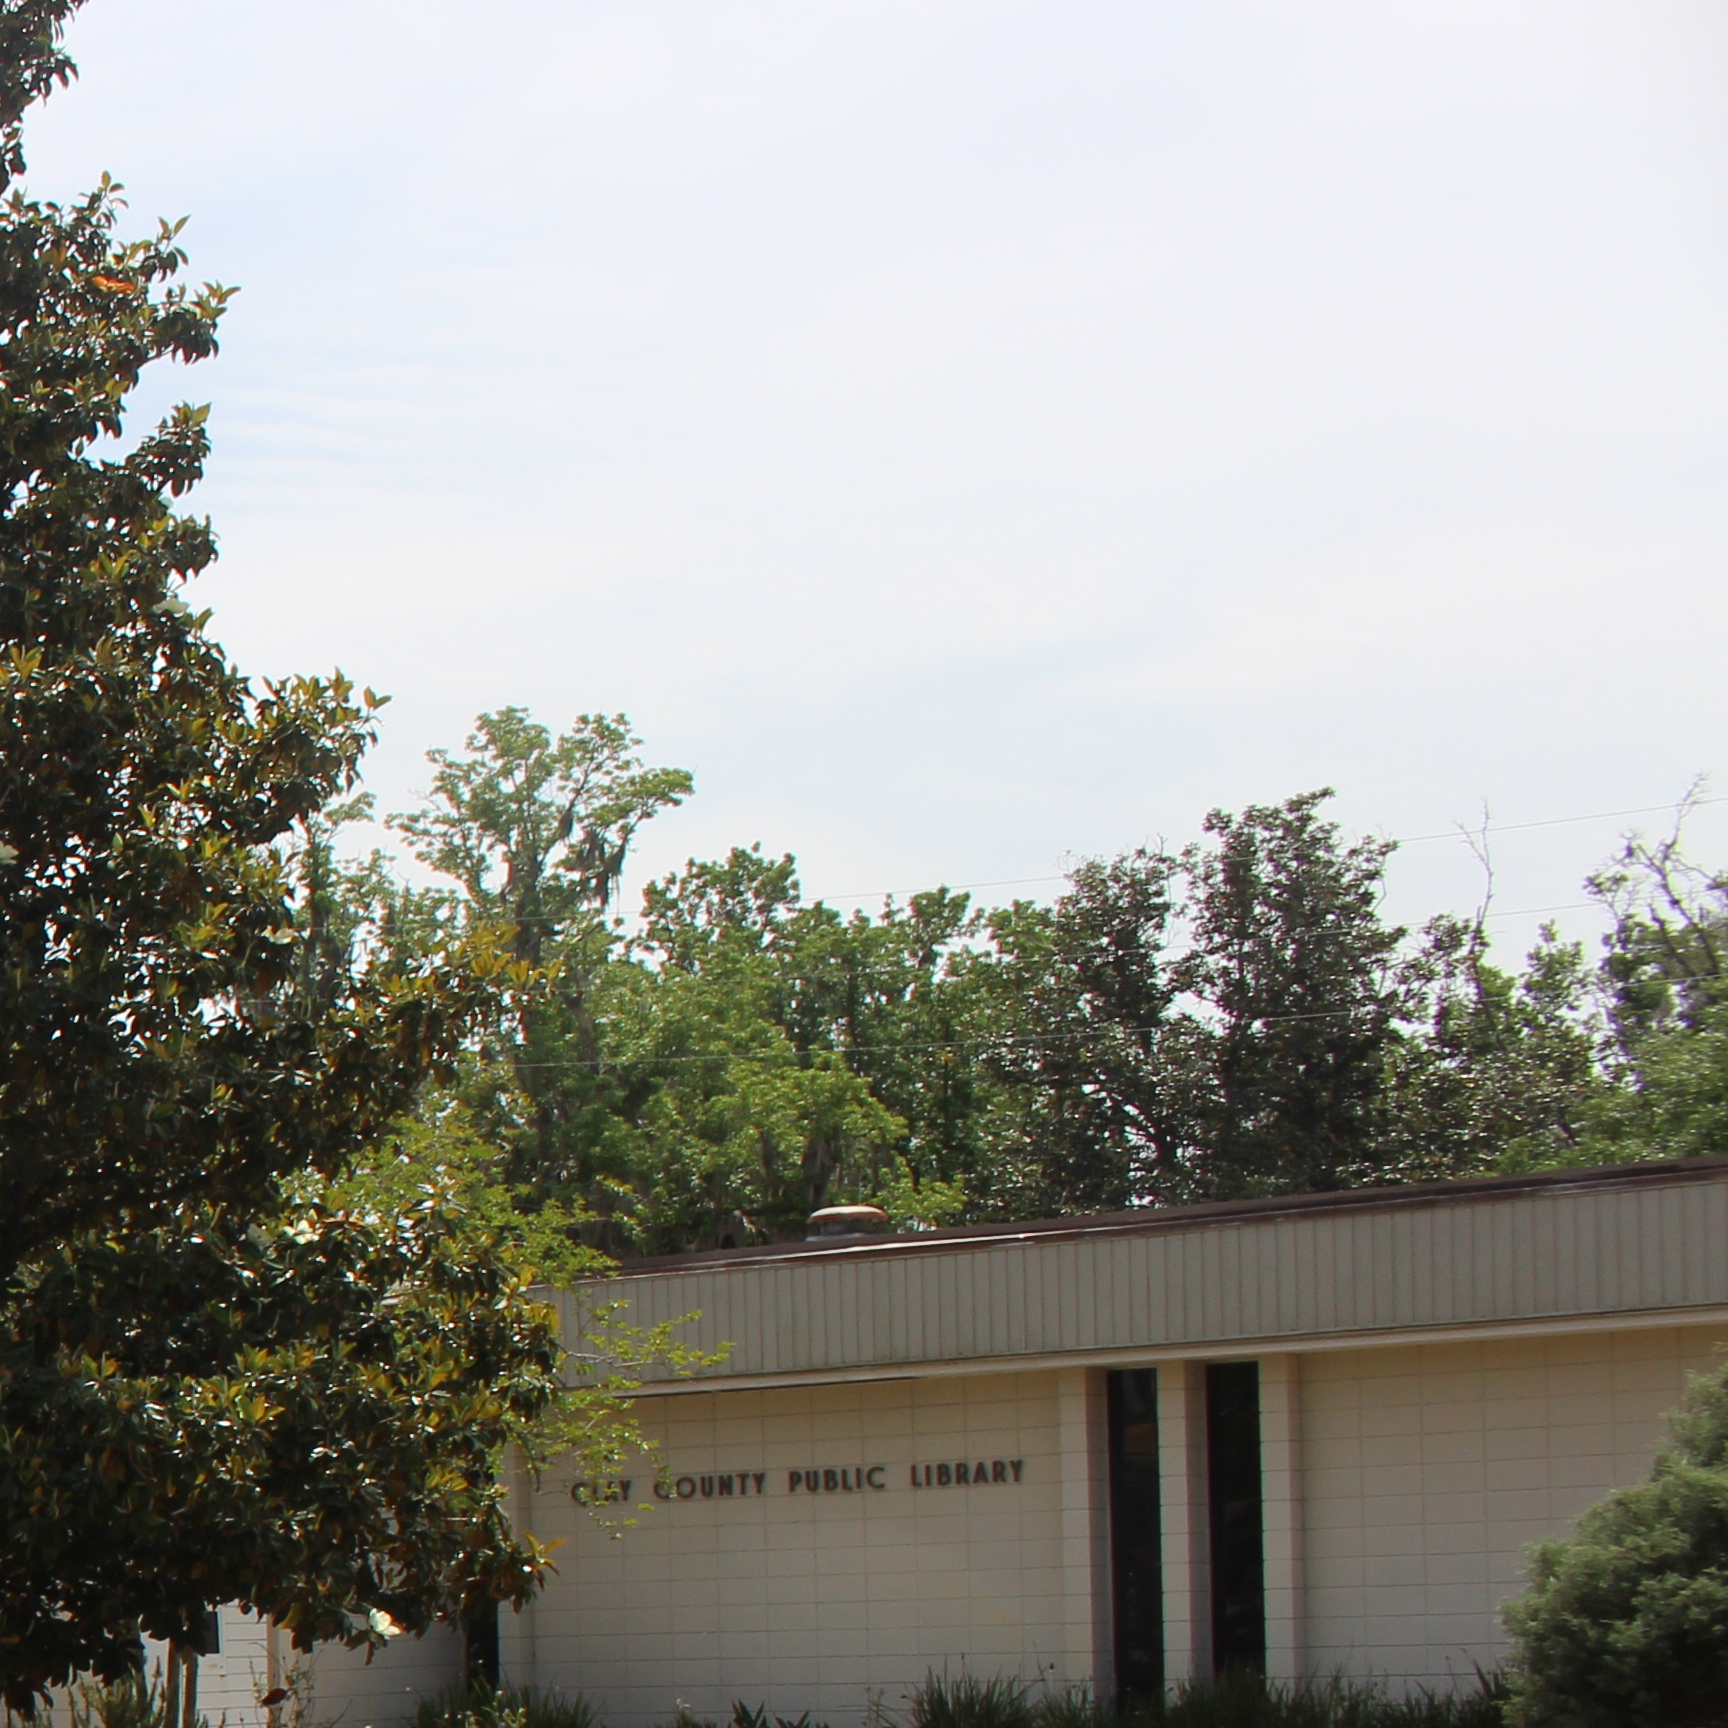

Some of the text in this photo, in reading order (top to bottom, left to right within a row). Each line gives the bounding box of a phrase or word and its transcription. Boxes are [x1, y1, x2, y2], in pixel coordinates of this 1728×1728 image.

[653, 1472, 766, 1499] COUNTY
[788, 1466, 886, 1493] PUBLIC
[910, 1459, 1024, 1487] LIBRARY
